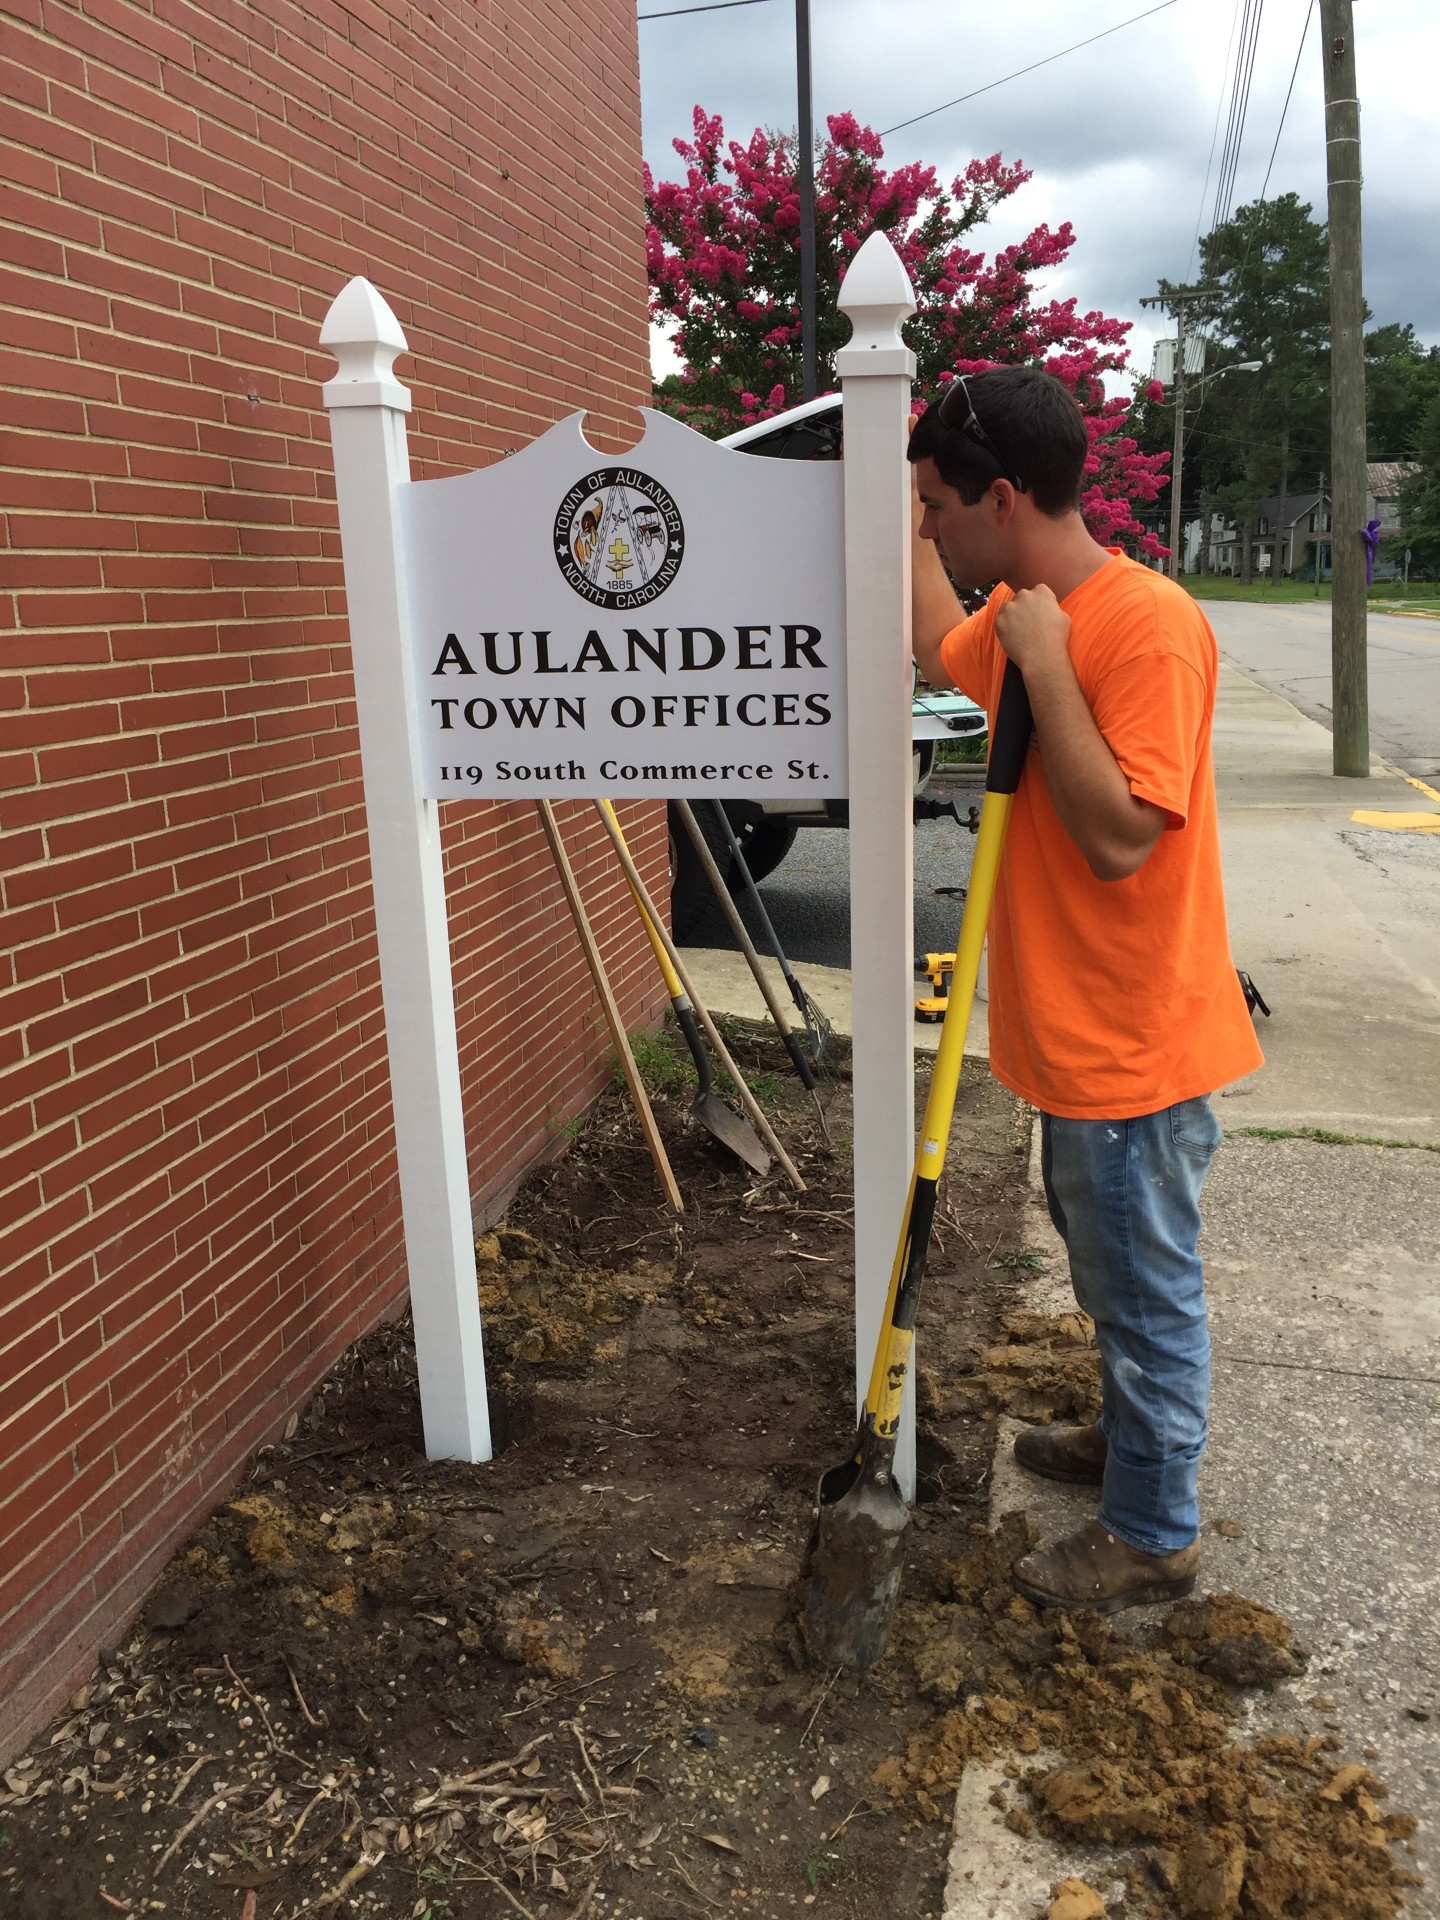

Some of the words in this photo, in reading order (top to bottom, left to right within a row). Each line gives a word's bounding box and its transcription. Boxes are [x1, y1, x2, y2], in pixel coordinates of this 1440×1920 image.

[556, 487, 585, 538] TOWN
[587, 472, 607, 490] OF
[615, 470, 681, 533] AULANDER
[563, 562, 607, 605] NORTH
[616, 558, 679, 608] CAROLINA
[606, 580, 633, 590] 1885
[431, 624, 829, 676] AULANDER
[430, 697, 587, 731] TOWN
[610, 693, 832, 729] OFFICES
[440, 765, 483, 785] 119
[496, 760, 587, 781] South
[599, 760, 774, 780] Commerce
[787, 759, 830, 780] St.
